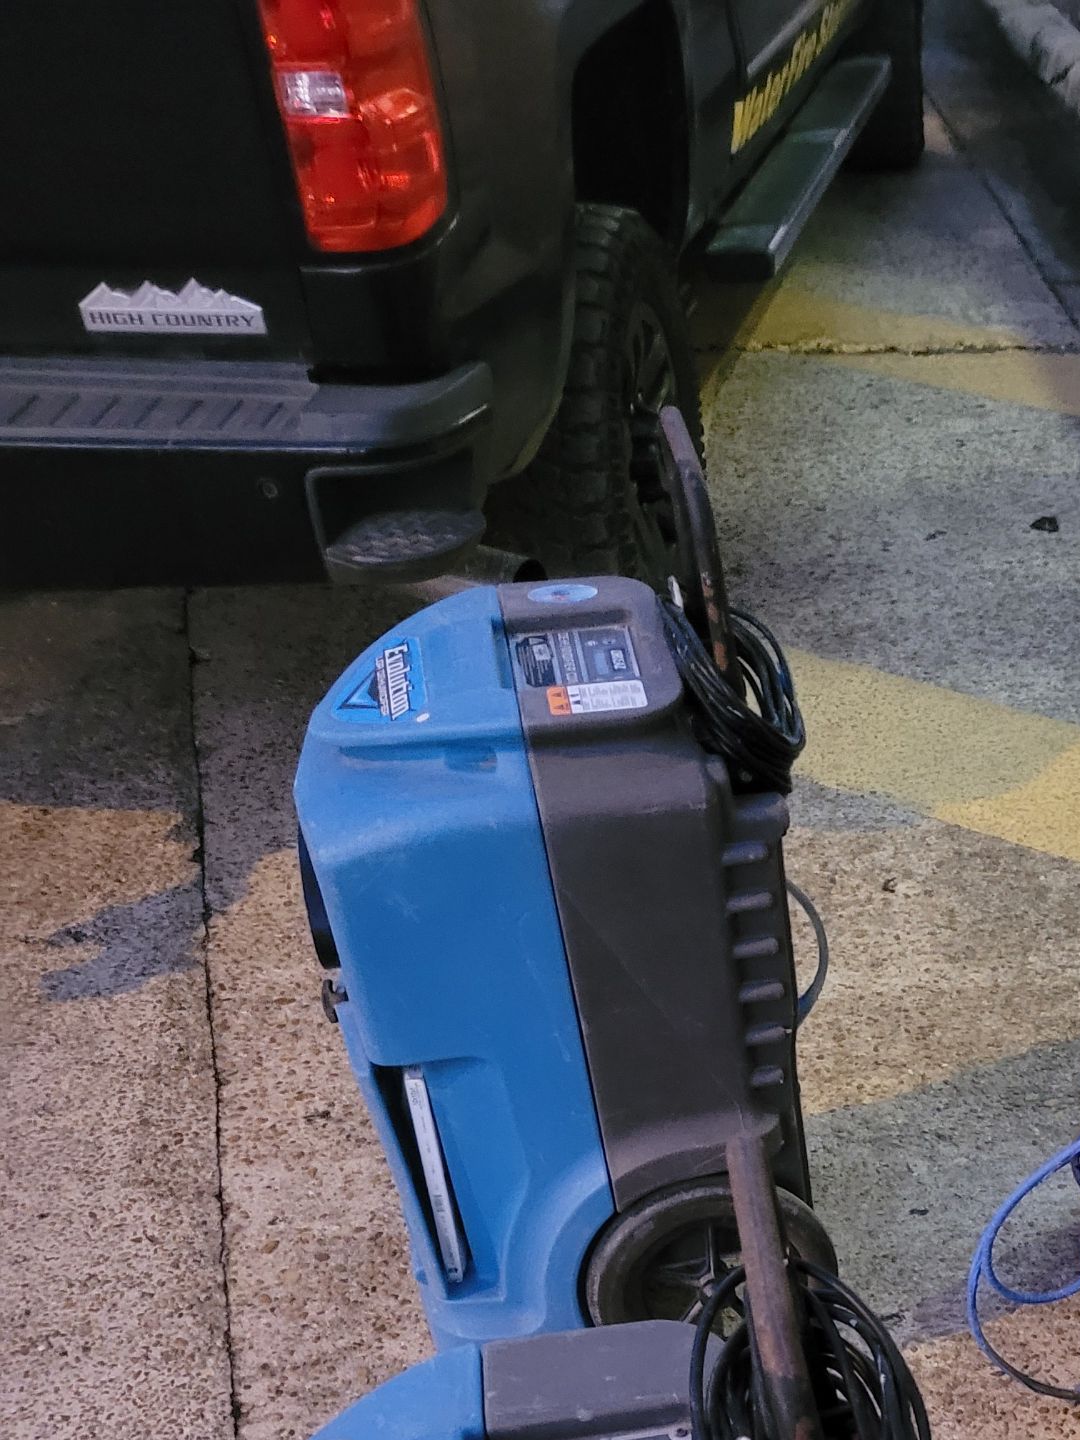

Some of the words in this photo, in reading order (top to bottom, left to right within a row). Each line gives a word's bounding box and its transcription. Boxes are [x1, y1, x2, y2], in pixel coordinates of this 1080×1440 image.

[88, 311, 144, 326] HIGH
[151, 313, 255, 328] COUNTRY
[383, 642, 411, 721] Evolution
